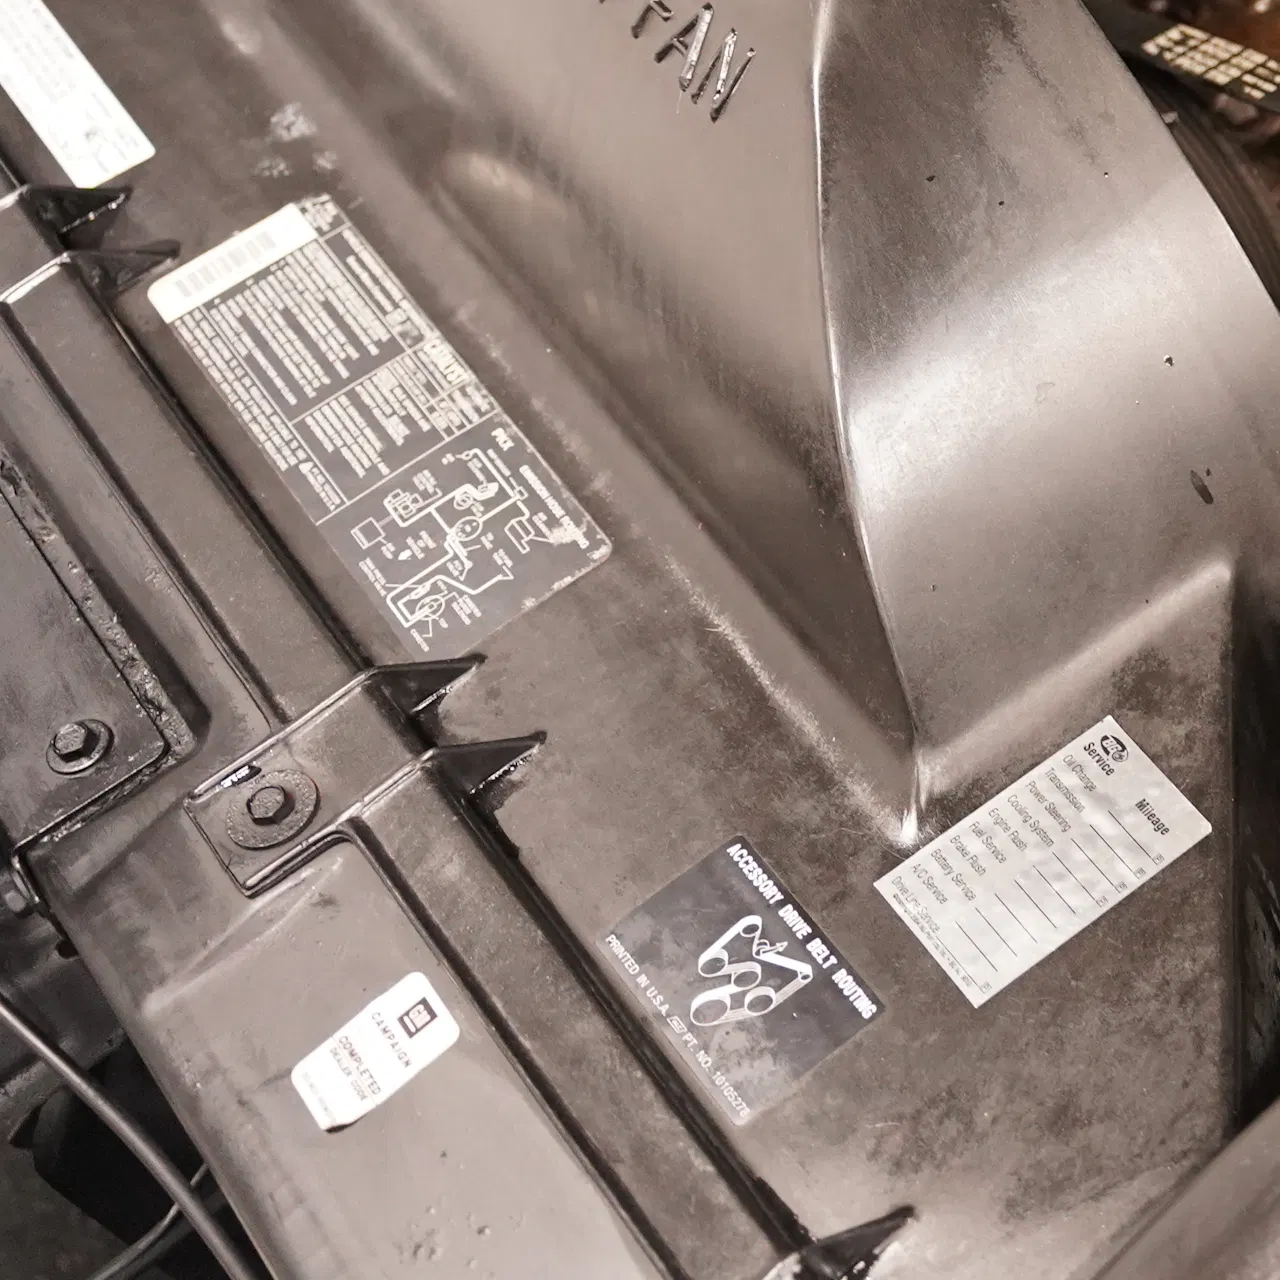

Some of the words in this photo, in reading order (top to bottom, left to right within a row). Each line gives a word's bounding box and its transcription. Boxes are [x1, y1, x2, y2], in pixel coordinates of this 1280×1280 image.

[421, 337, 469, 387] CATALYST
[1043, 767, 1086, 814] Transmission
[1061, 753, 1077, 768] Oil
[1069, 763, 1098, 793] Change
[1081, 741, 1116, 777] Service
[1133, 798, 1172, 837] Mileage
[986, 807, 1013, 835] Engine
[1005, 793, 1034, 824] Cooling
[1026, 819, 1055, 849] System
[1024, 780, 1051, 807] Power
[1042, 802, 1072, 833] Steering
[948, 834, 972, 858] Brake
[968, 820, 987, 839] Fuel
[980, 834, 1009, 864] Service
[909, 861, 928, 880] A/C
[921, 875, 949, 905] Service
[929, 848, 956, 877] Battery
[950, 872, 978, 902] Service
[724, 839, 785, 907] ACCESSORY
[776, 902, 813, 941] DRIVE
[804, 935, 838, 972] BELT
[830, 966, 879, 1020] ROUTING
[890, 875, 912, 897] Drive
[915, 905, 942, 933] Service
[602, 932, 641, 977] PRINTED
[634, 972, 651, 989] IN
[679, 1030, 700, 1052] PT.
[693, 1048, 716, 1072] NO.
[338, 1033, 381, 1096] COMPLETED
[371, 1009, 412, 1069] CAMPAIGN
